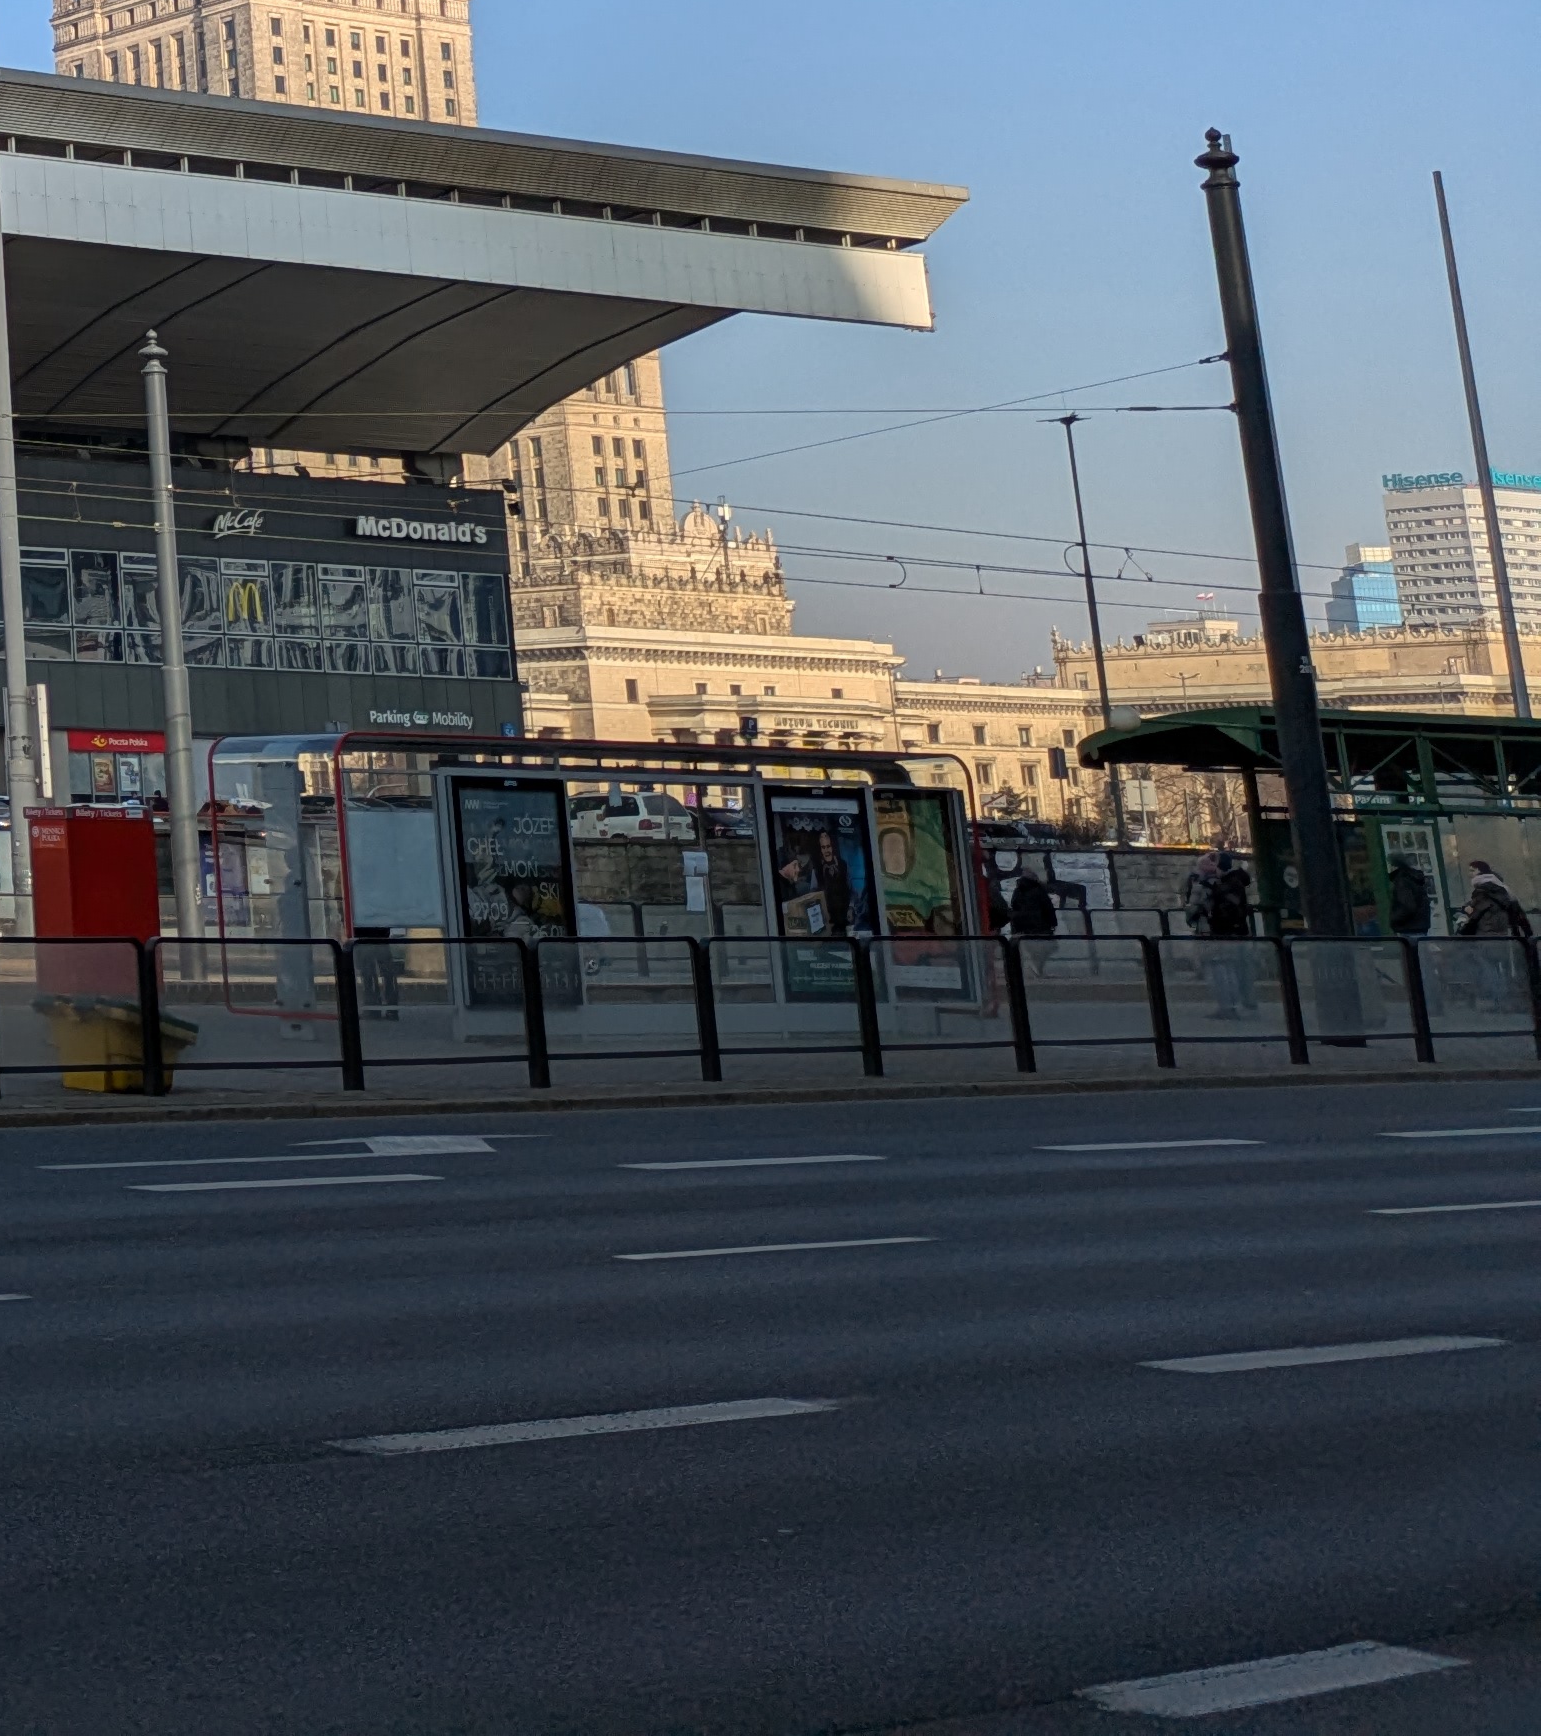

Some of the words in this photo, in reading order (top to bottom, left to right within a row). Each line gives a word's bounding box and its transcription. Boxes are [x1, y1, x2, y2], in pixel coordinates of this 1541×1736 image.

[1382, 471, 1464, 488] Hisense
[213, 510, 264, 535] McCafé
[356, 515, 488, 544] McDonald's
[369, 710, 412, 728] Parking
[432, 711, 473, 730] Mobility
[108, 737, 129, 746] Poczta
[129, 738, 148, 747] Polska
[75, 809, 96, 819] Bilety
[100, 810, 123, 819] Tickets
[513, 813, 555, 835] JÓZEF
[467, 837, 504, 856] CHEŁ
[504, 855, 539, 878] MOŃ
[539, 881, 560, 901] SKI
